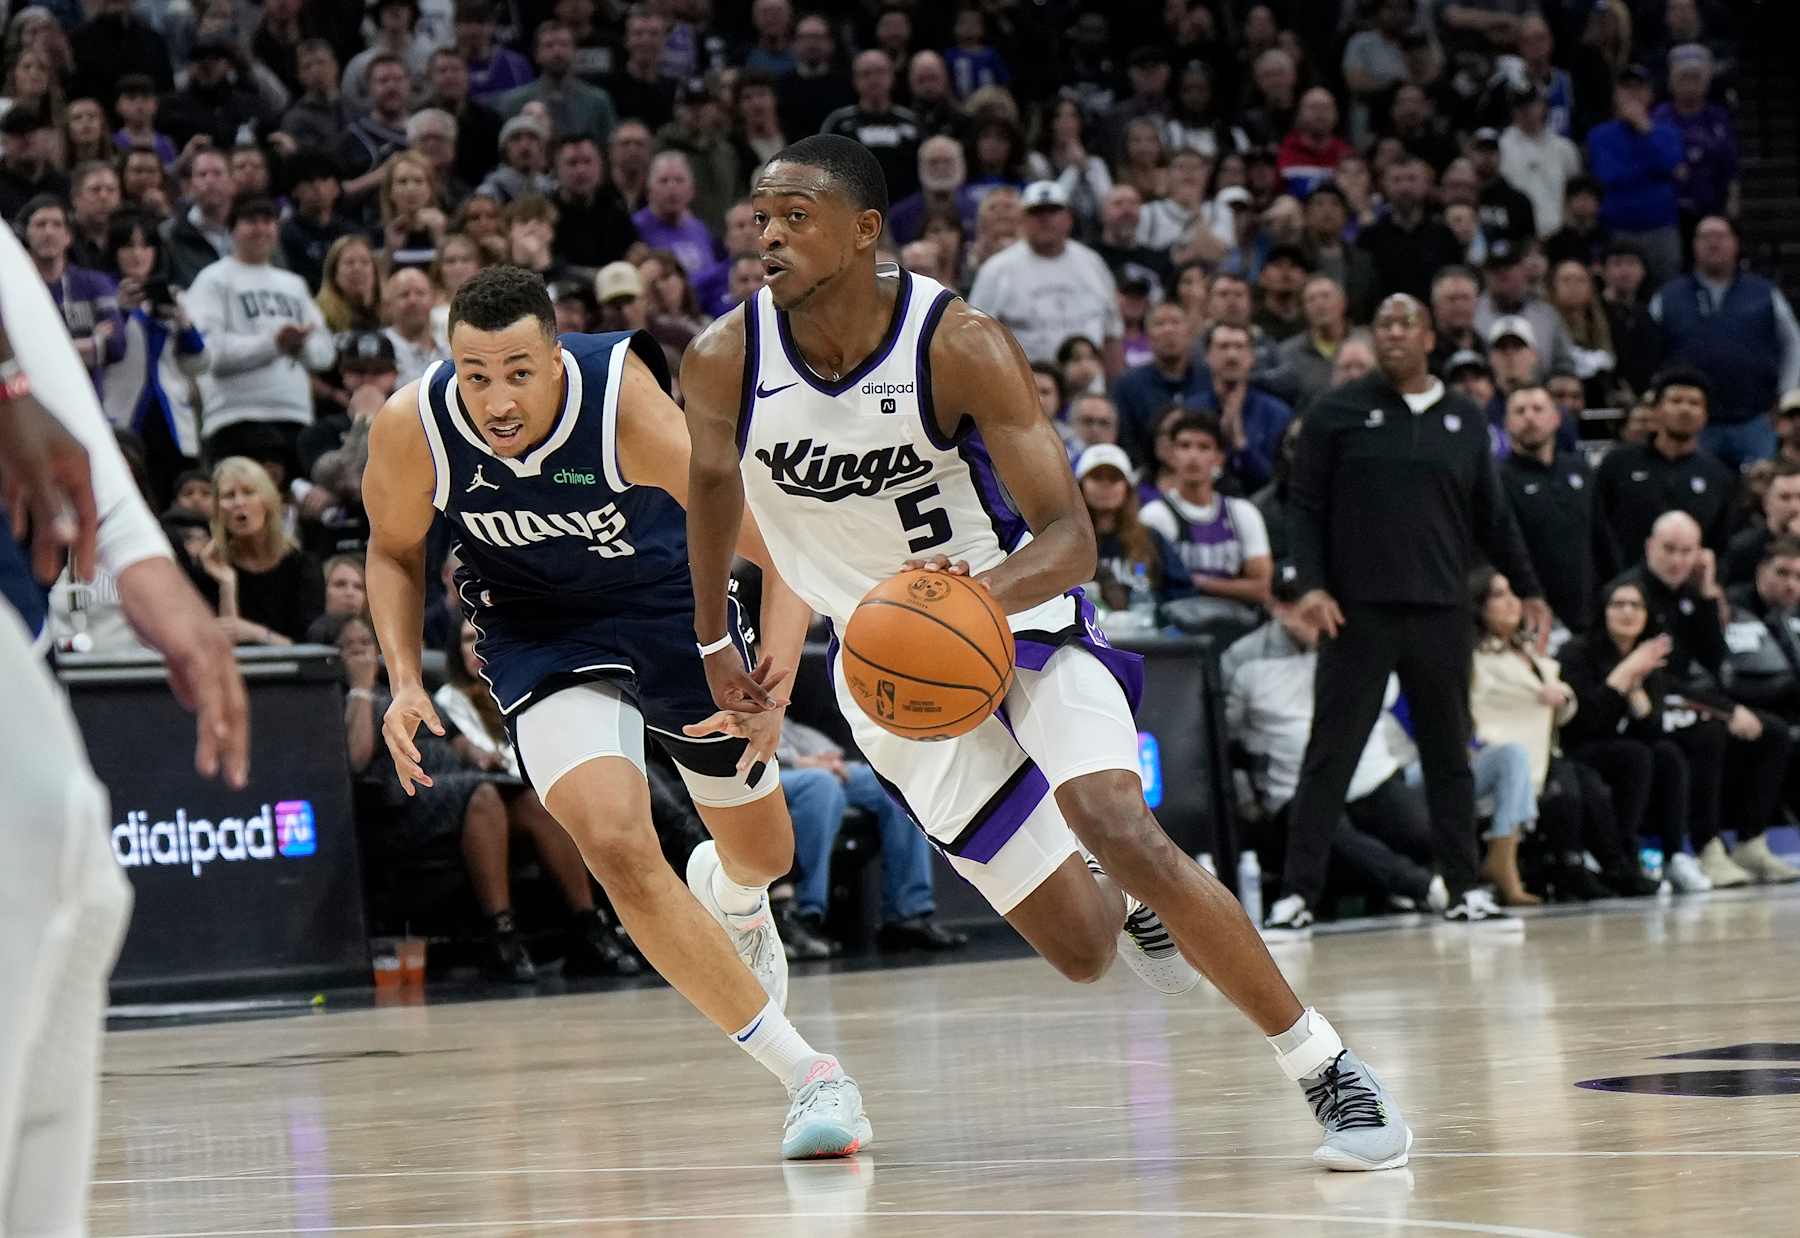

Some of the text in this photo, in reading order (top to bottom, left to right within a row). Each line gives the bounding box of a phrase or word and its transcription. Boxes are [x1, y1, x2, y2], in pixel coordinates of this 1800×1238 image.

[862, 381, 914, 397] dialpad
[553, 468, 597, 485] chime
[755, 438, 933, 502] Kings
[460, 502, 627, 547] MAVS
[894, 482, 953, 554] 5
[111, 803, 275, 877] dialpad
